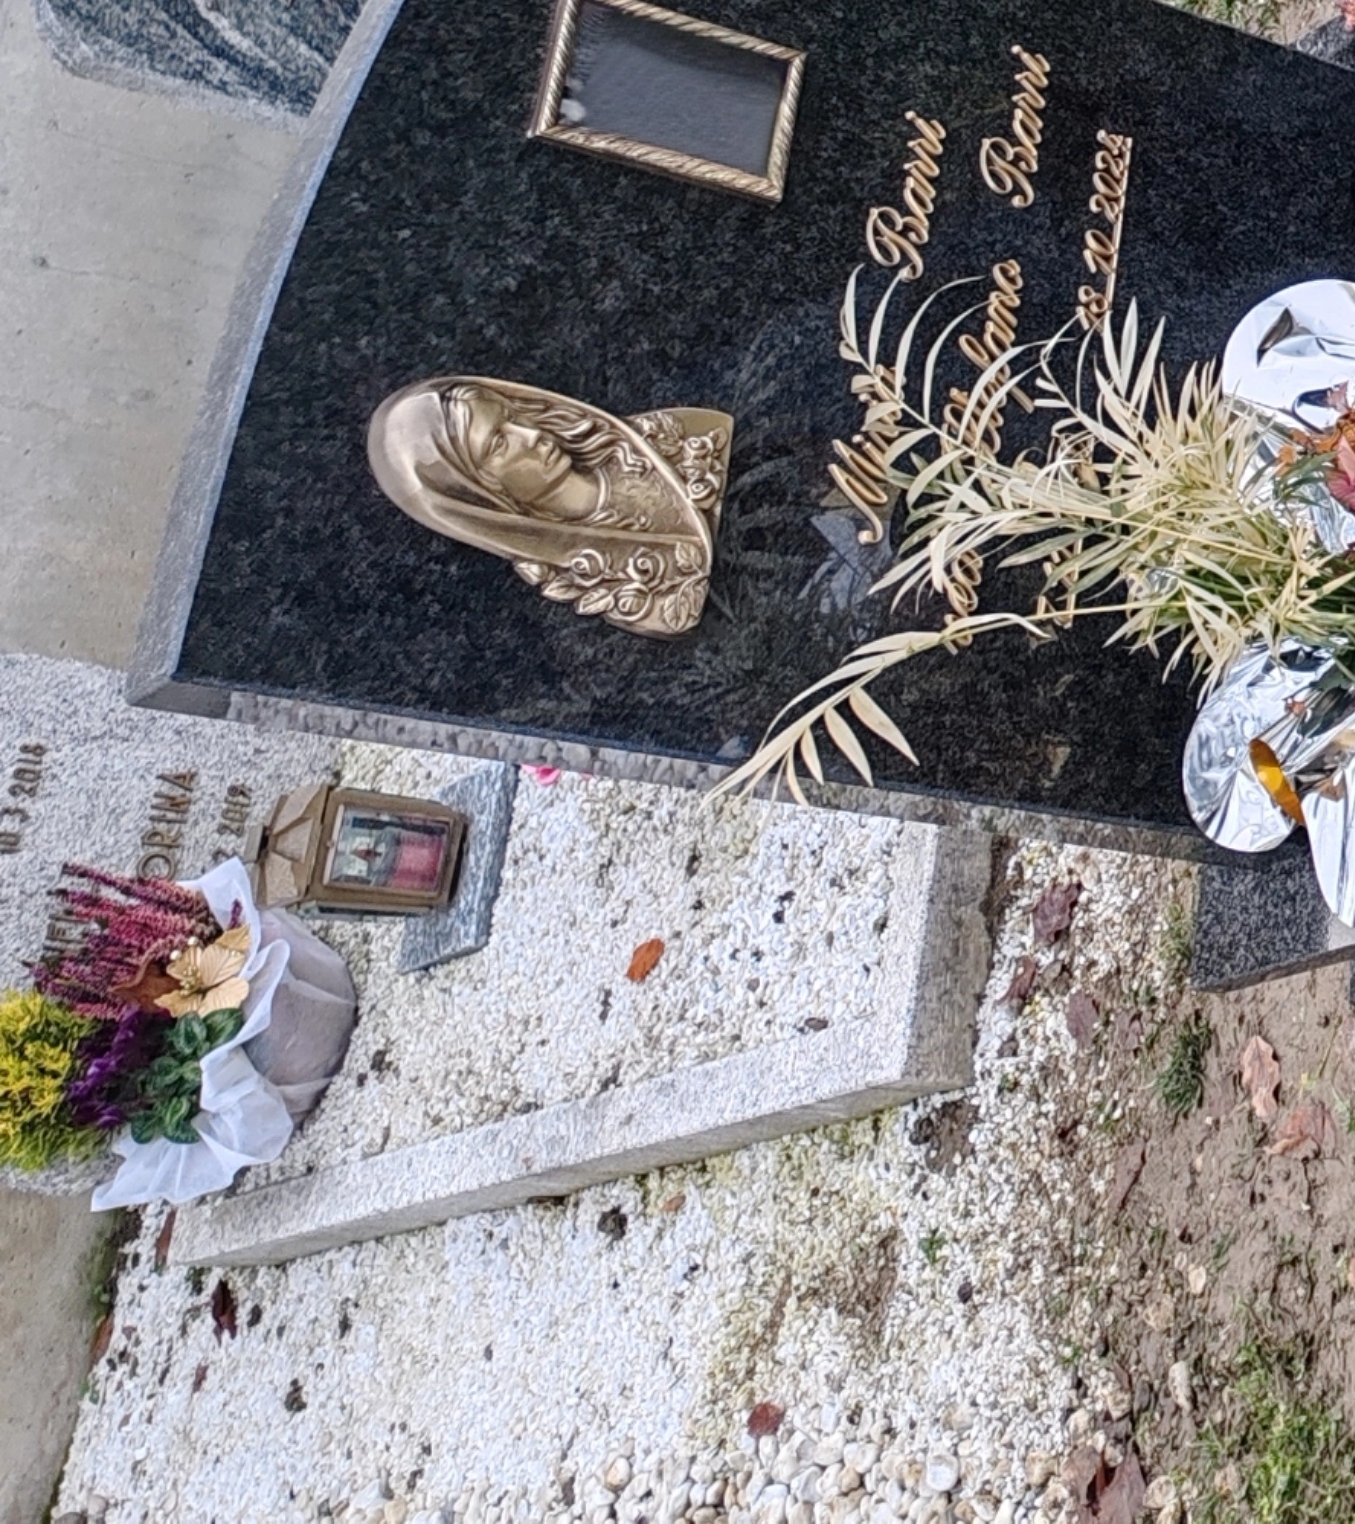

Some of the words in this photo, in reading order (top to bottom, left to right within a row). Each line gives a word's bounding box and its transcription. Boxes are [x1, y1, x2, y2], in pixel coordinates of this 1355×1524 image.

[980, 44, 1051, 209] Barri
[865, 111, 946, 280] Barri
[1088, 129, 1133, 224] 2024
[1082, 228, 1120, 275] 10
[8, 741, 48, 798] 2018
